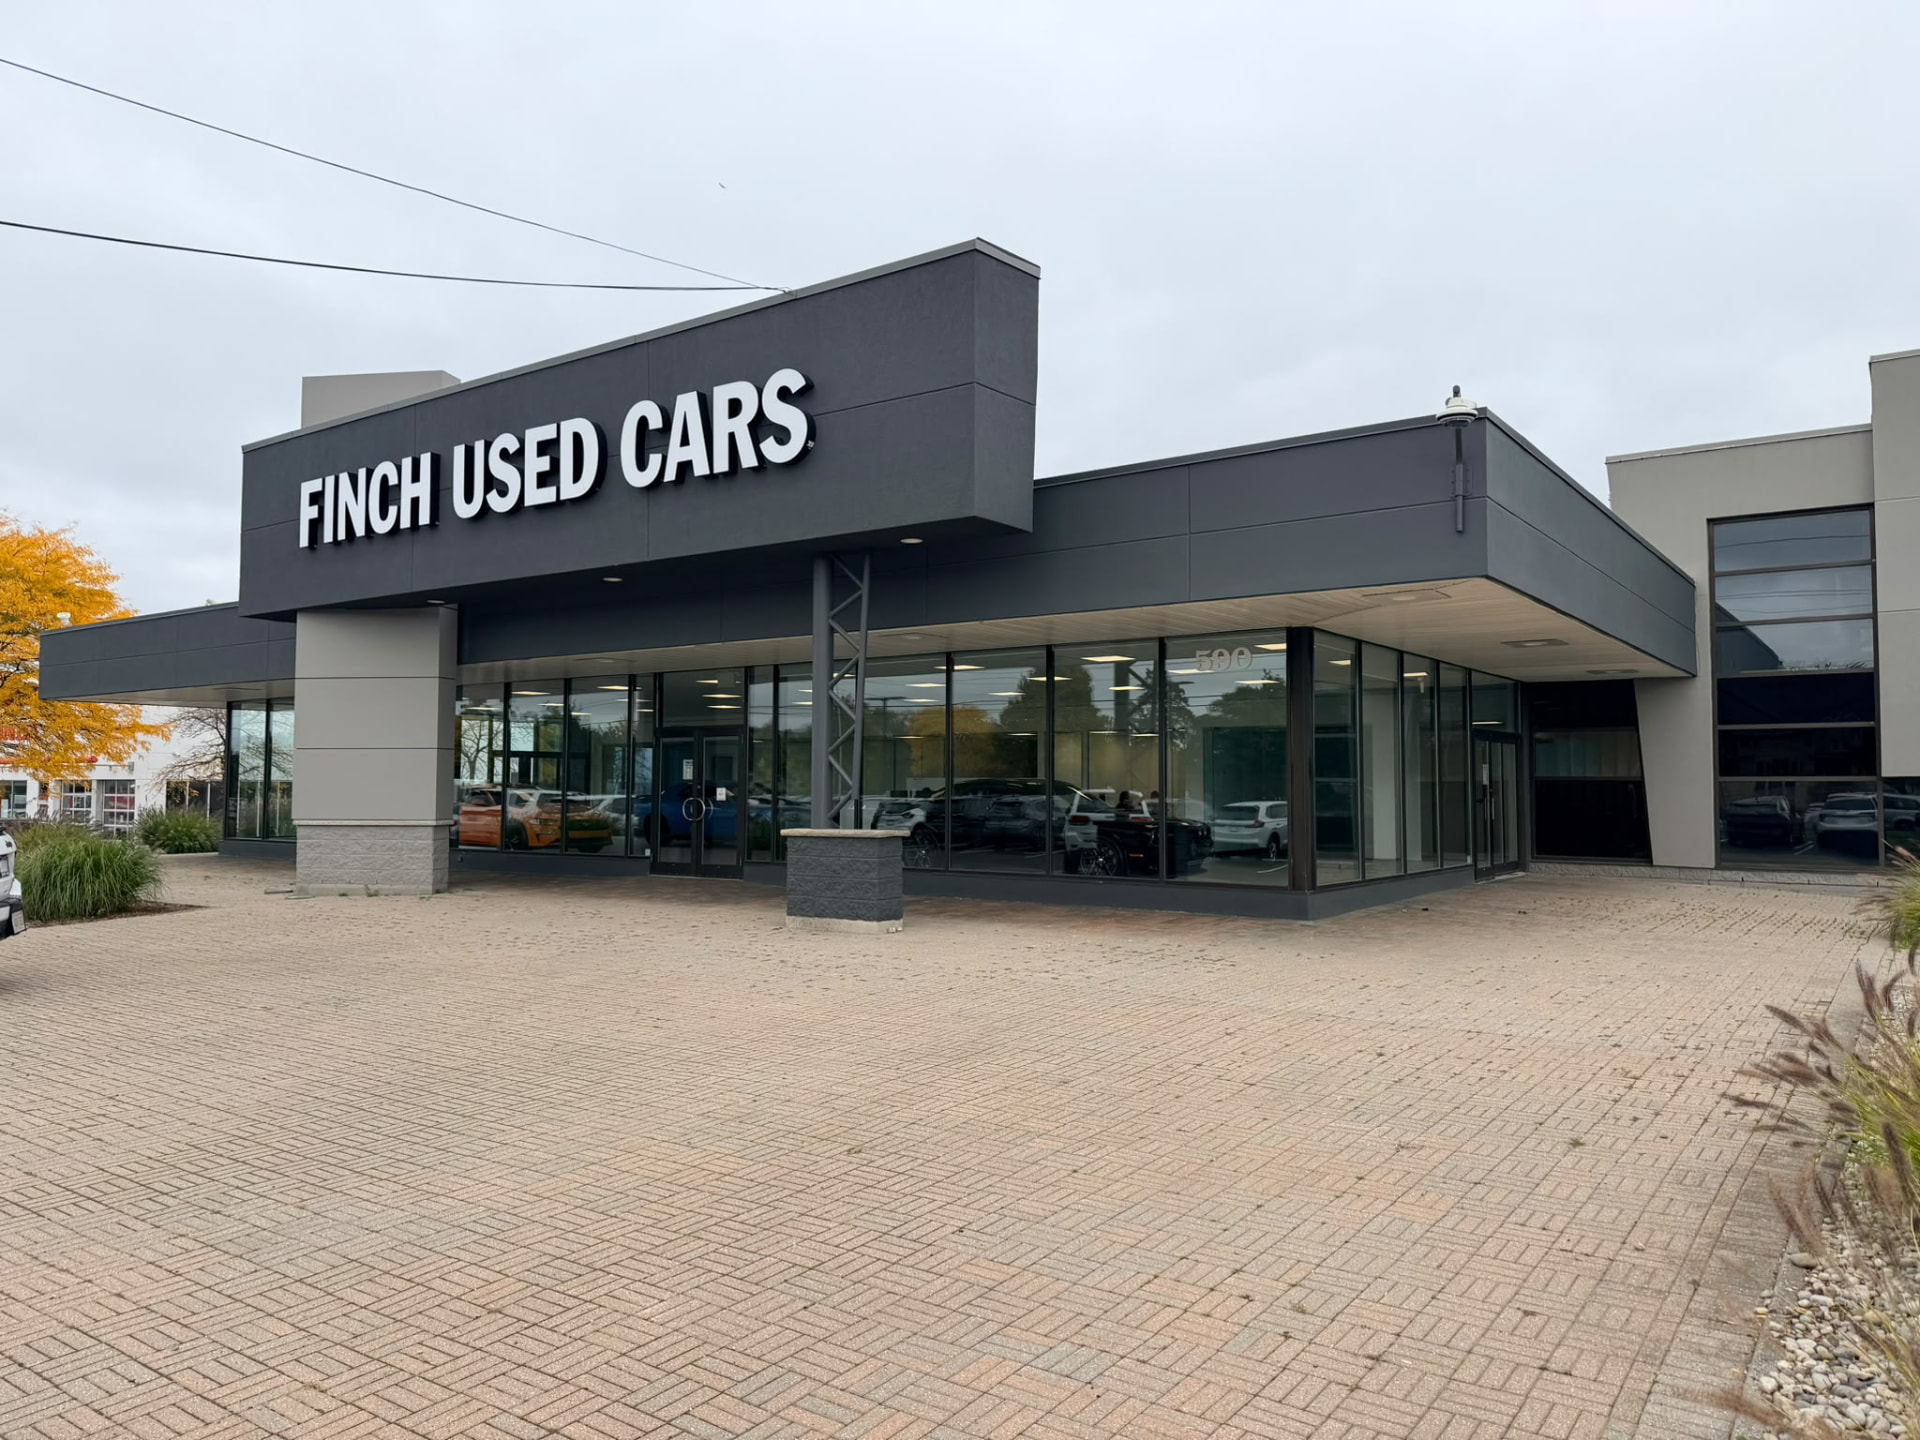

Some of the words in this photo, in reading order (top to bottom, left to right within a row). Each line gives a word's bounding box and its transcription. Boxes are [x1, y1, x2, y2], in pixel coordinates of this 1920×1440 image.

[299, 451, 432, 549] FINCH
[452, 417, 600, 520] USED
[620, 368, 809, 489] CARS
[1195, 647, 1253, 672] 590
